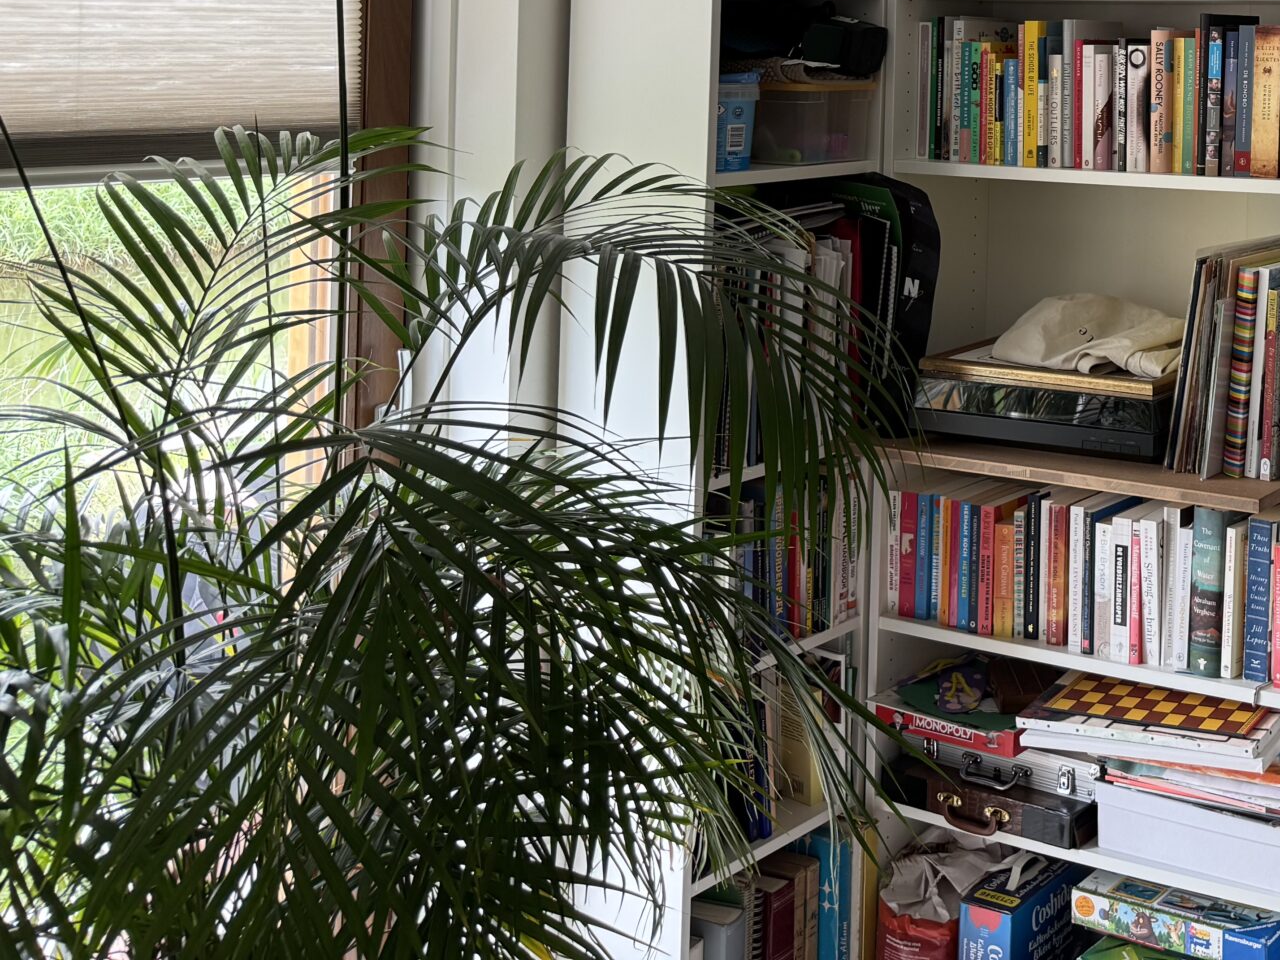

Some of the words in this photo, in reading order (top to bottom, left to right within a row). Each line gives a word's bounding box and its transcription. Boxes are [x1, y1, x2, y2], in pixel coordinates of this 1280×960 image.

[1155, 42, 1163, 66] SALLY
[1243, 70, 1248, 78] DE
[1117, 547, 1122, 555] DE
[915, 718, 972, 739] MONOPOLY
[1225, 933, 1262, 948] Ravensburger
